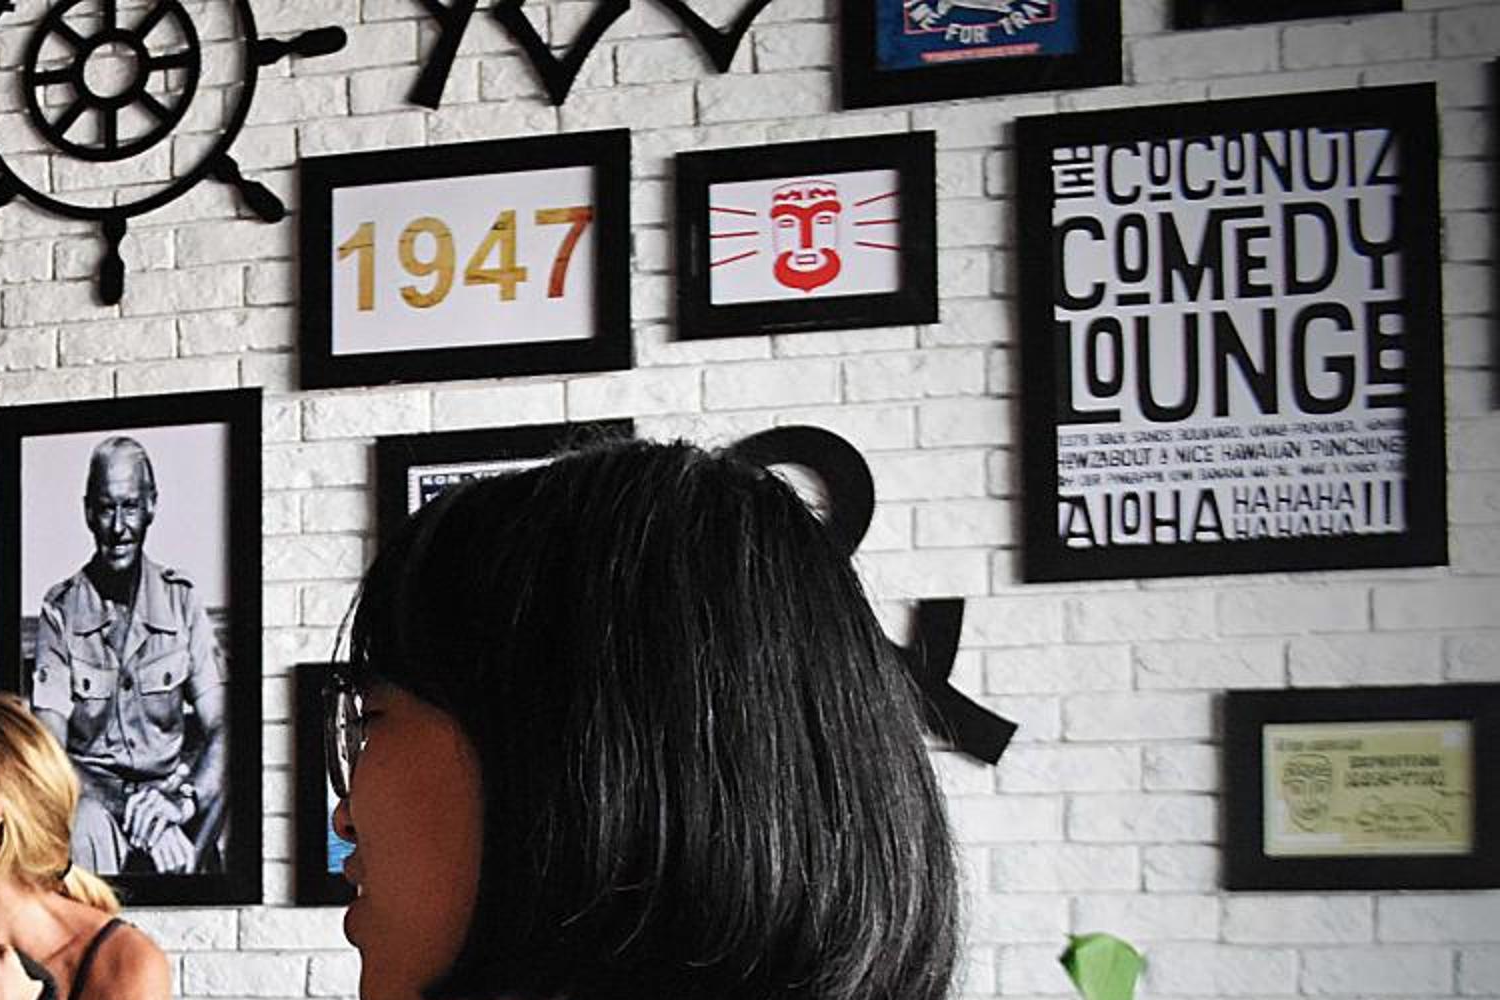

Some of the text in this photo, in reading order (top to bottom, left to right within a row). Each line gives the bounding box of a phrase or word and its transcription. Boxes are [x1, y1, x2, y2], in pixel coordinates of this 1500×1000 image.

[944, 23, 991, 44] FOR
[1105, 126, 1401, 206] COCONUTZ
[337, 206, 594, 311] 1947
[1051, 196, 1403, 312] COMEDY
[1051, 299, 1407, 425] LOUNGE
[1174, 444, 1215, 464] NICE
[1057, 486, 1227, 547] ALOHA
[1231, 480, 1356, 514] HAHAHA
